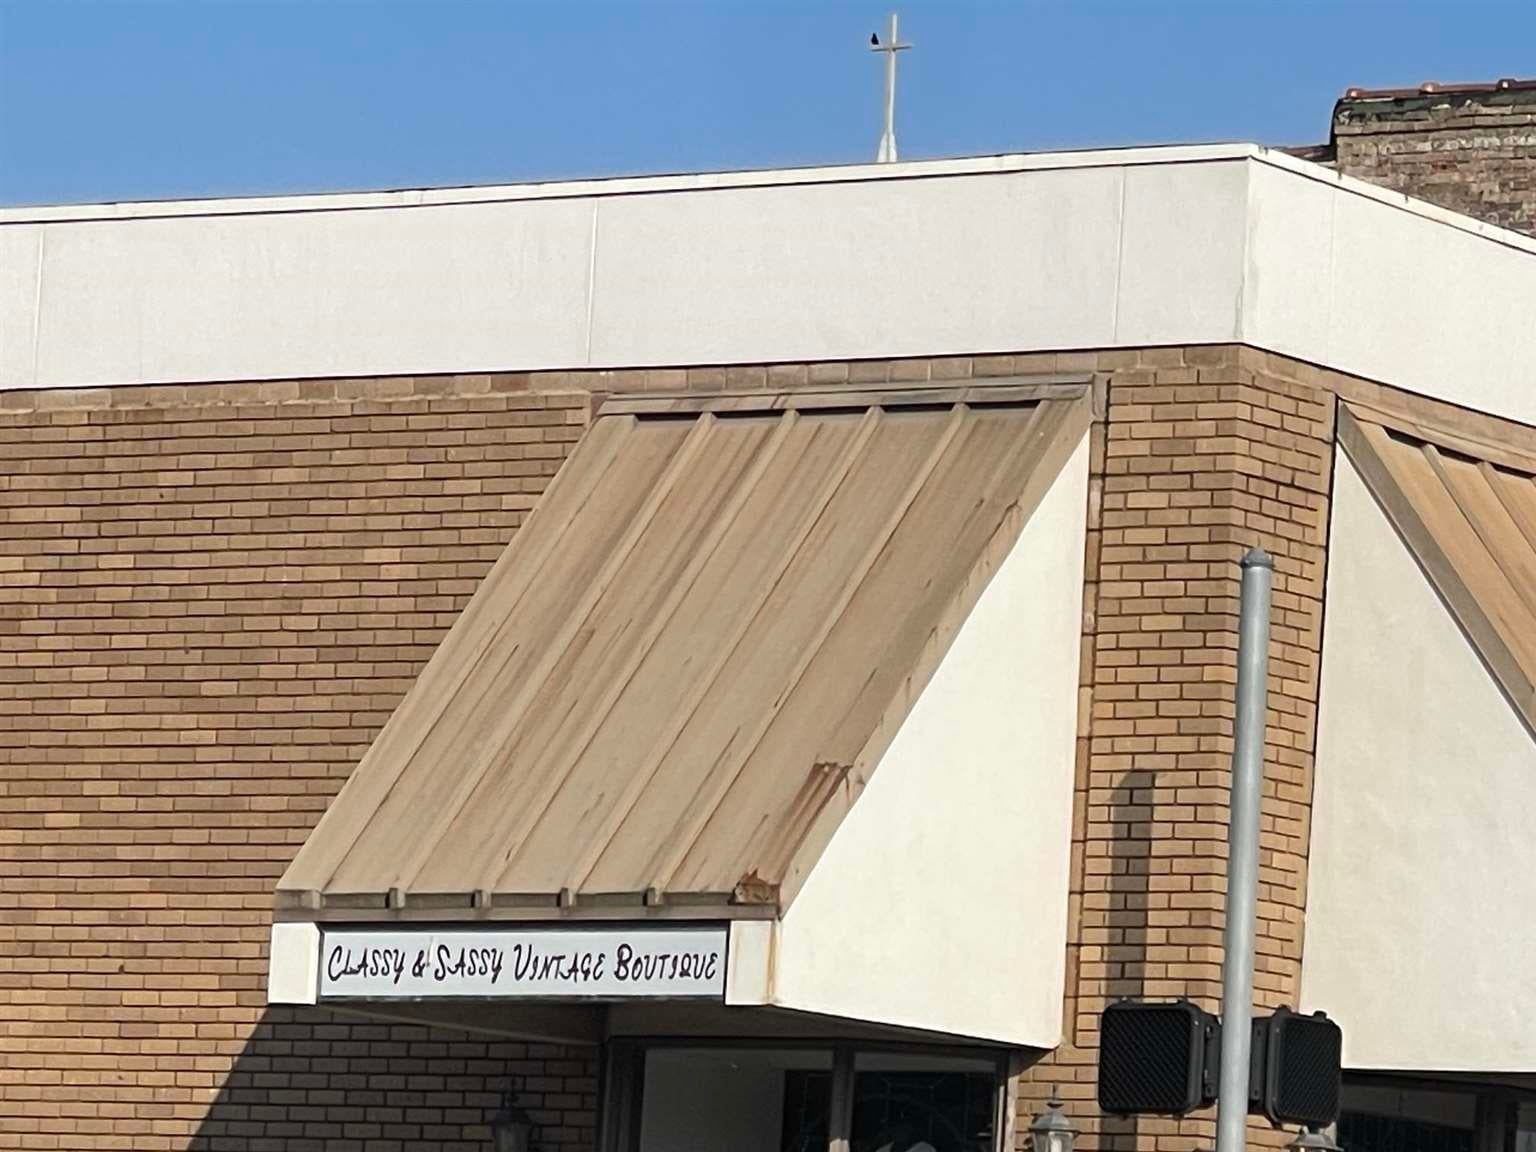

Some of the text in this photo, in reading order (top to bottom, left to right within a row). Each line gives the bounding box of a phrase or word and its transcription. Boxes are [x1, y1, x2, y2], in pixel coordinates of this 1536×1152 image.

[328, 942, 718, 985] CLASSY & SASSY VINTAGE BOUTIQUE
